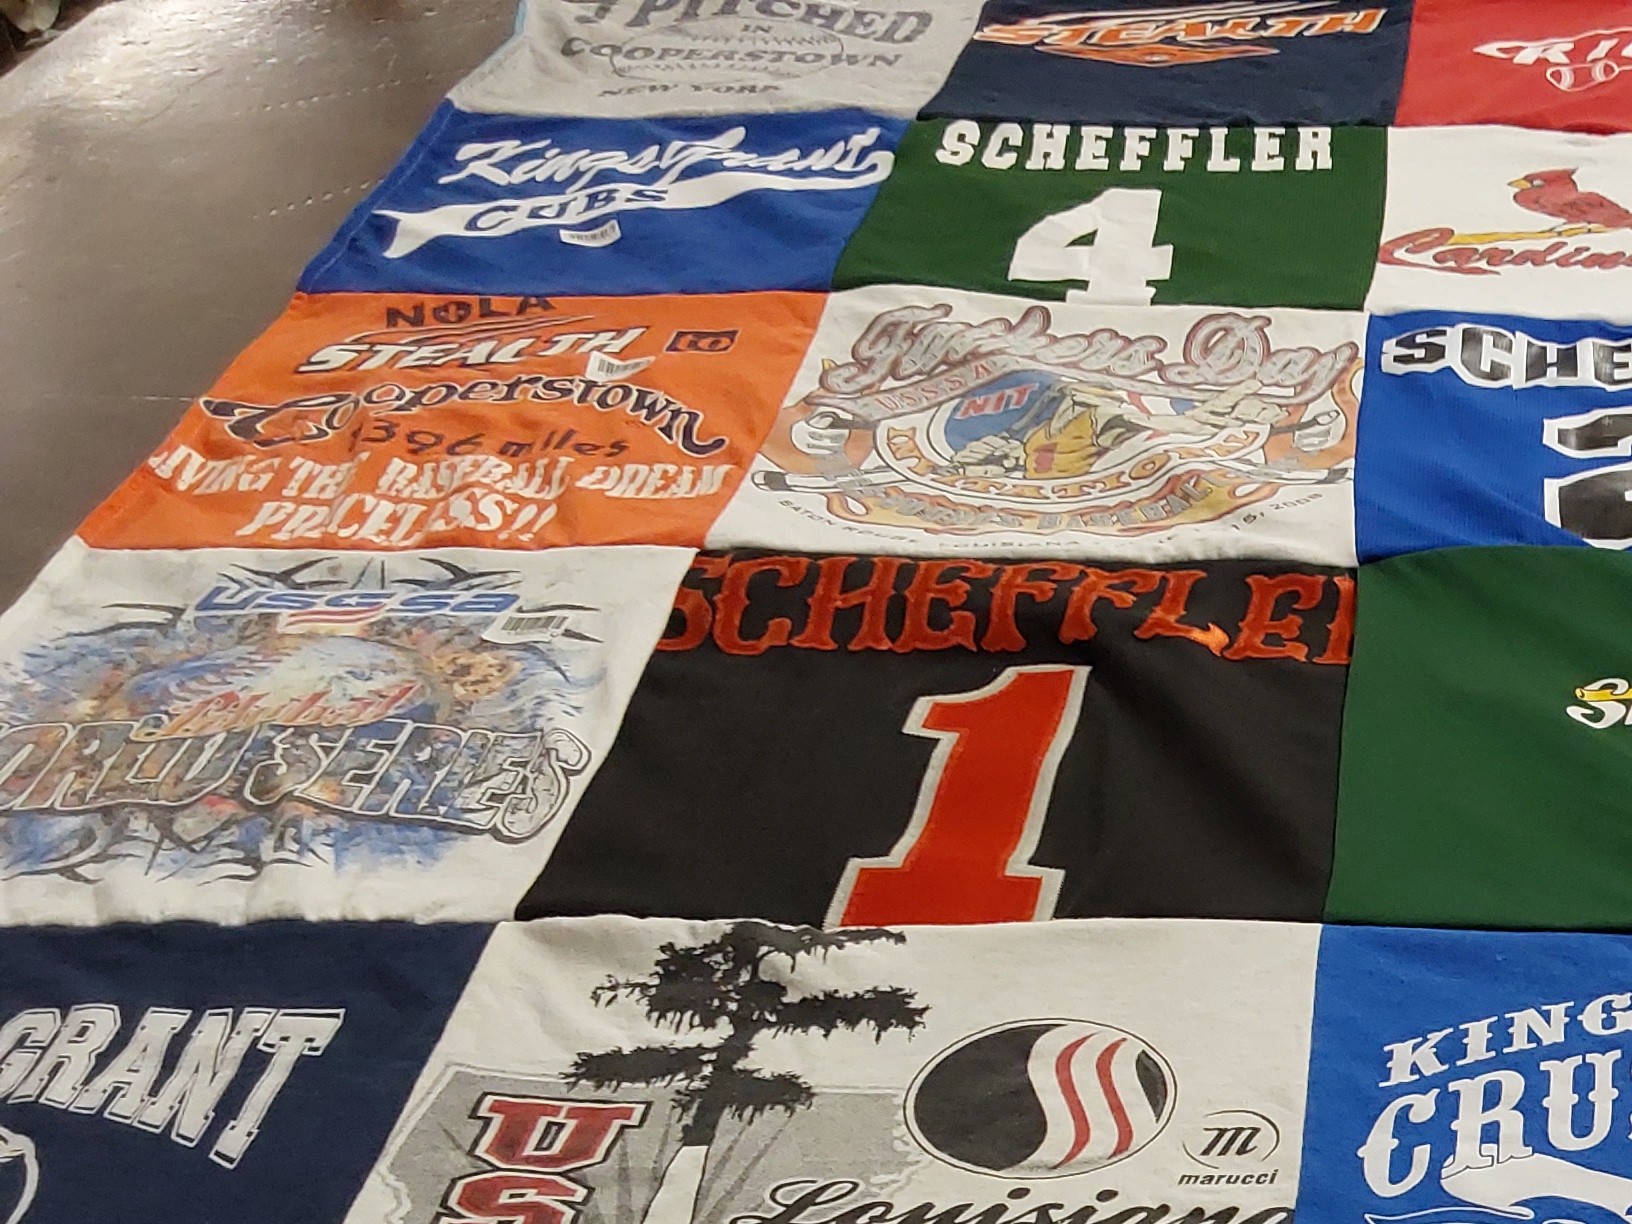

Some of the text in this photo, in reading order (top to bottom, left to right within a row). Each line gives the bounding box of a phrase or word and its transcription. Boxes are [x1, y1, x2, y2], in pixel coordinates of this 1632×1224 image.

[974, 8, 1388, 46] STEALTH
[561, 37, 902, 67] COOPERSTOWN
[937, 119, 1333, 172] SCHEFFLER
[1008, 187, 1174, 305] 4
[384, 296, 557, 329] NOLA
[296, 326, 650, 376] STEALTH
[200, 374, 729, 456] Cooperstown
[952, 382, 1040, 420] NIT
[823, 664, 1094, 931] 1
[1177, 1168, 1280, 1187] marucci
